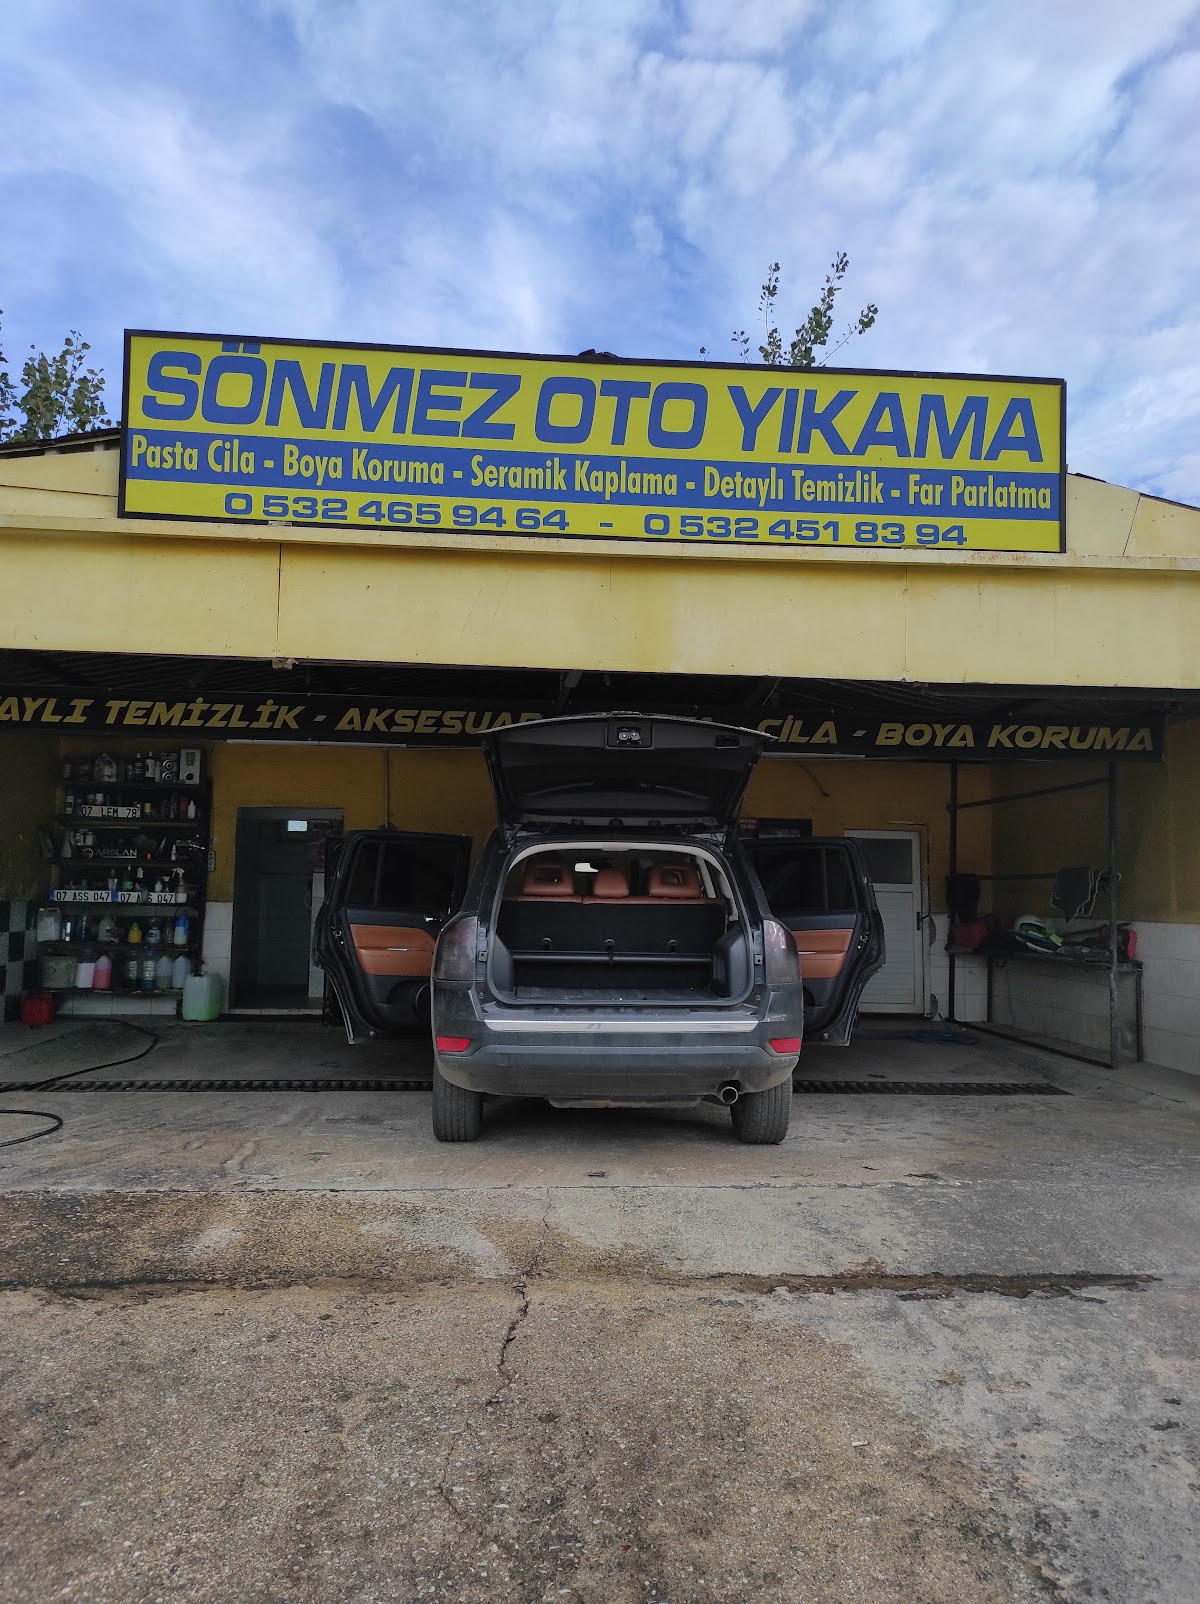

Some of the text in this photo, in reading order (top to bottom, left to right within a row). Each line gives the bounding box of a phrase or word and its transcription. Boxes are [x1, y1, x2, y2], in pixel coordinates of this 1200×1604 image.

[142, 341, 1044, 463] SÖNMEZ OTO YIKAMA
[131, 434, 198, 471] Pasta
[207, 439, 255, 474] Cila
[283, 443, 343, 486] Boya
[352, 447, 445, 485] Koruma
[471, 455, 567, 491] Seramik
[575, 460, 677, 500] Kaplama
[703, 465, 784, 507] Detaylı
[791, 469, 884, 504] Temizlik
[908, 473, 944, 506] Far
[951, 475, 1051, 509] Parlatma
[224, 492, 253, 515] 0
[262, 495, 348, 521] 532
[358, 500, 441, 525] 465
[452, 504, 507, 528] 94
[515, 507, 570, 531] 64
[644, 513, 670, 536] 0
[679, 515, 759, 539] 532
[768, 519, 839, 542] 451
[855, 521, 905, 544] 83
[915, 523, 967, 545] 94
[105, 699, 305, 730] TEMİZLİK
[876, 723, 976, 747] BOYA
[988, 726, 1155, 751] KORUMA
[56, 891, 110, 902] 07 ASS 047
[120, 893, 174, 903] 07 AS 047
